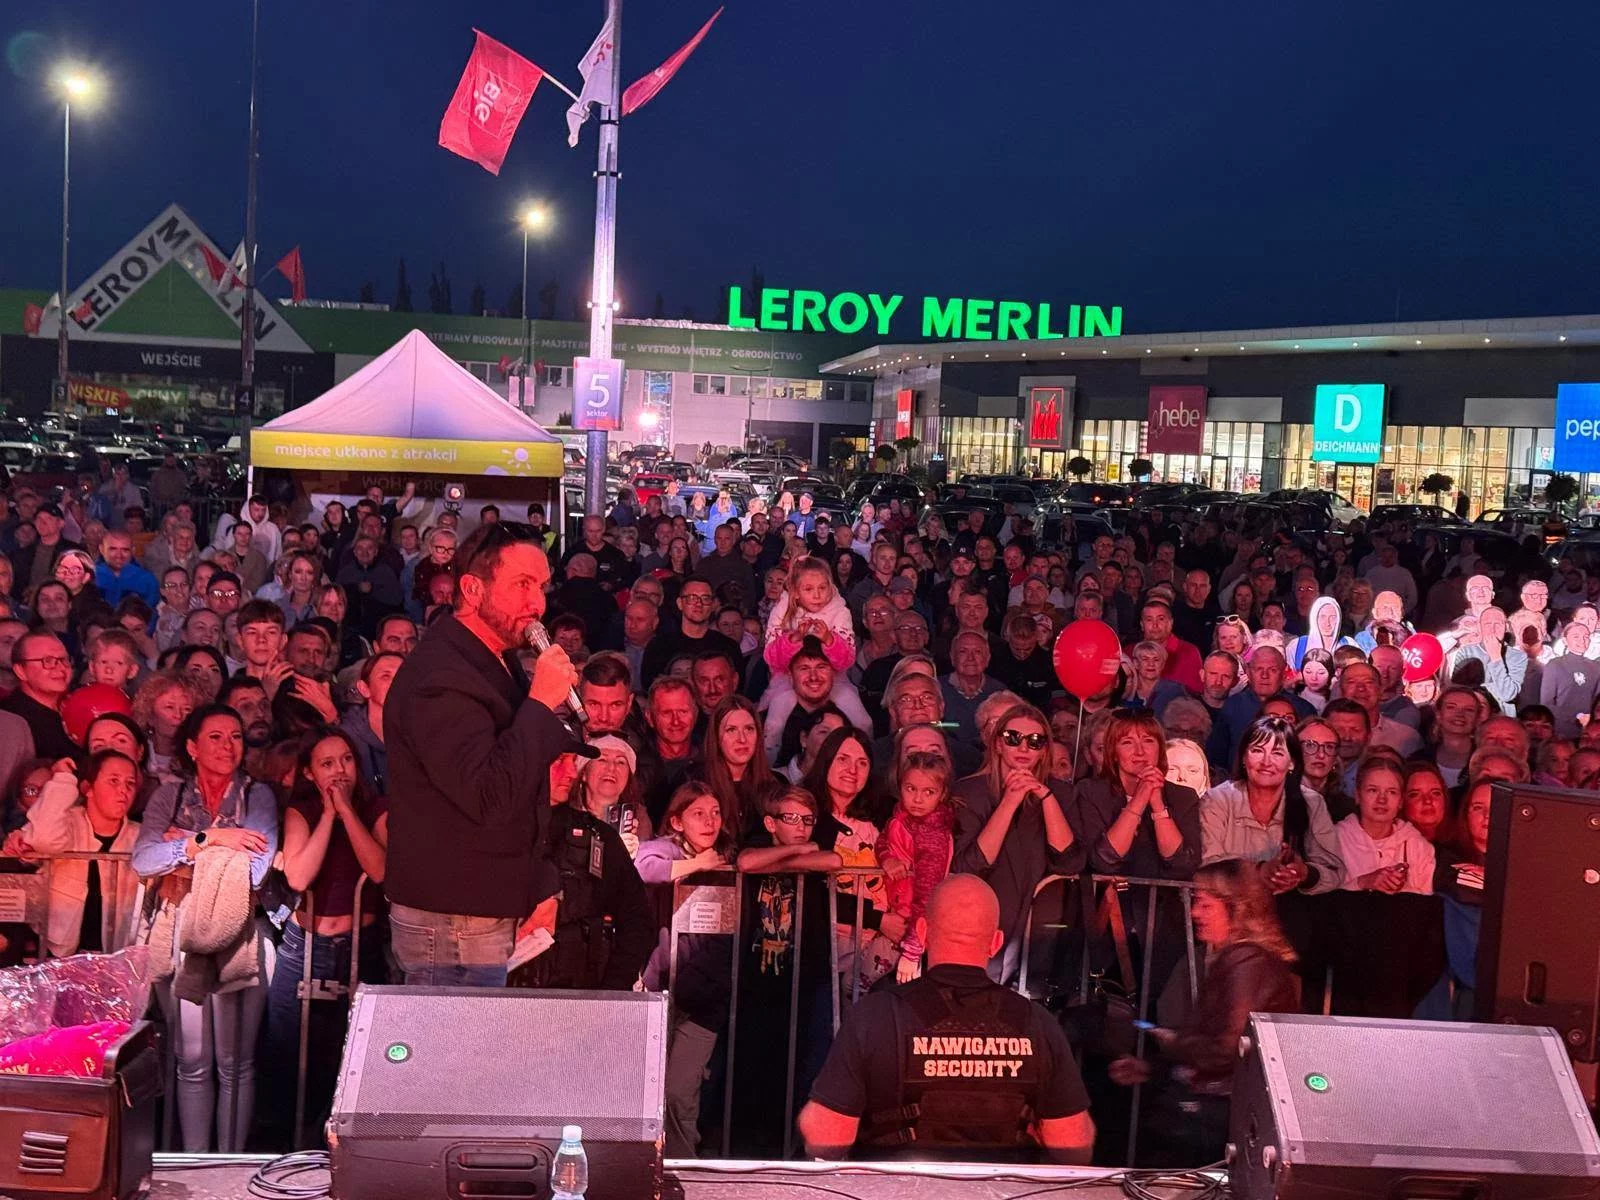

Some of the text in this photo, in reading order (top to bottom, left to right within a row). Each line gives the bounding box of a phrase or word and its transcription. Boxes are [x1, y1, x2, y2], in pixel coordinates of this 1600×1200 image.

[67, 234, 164, 332] LEROY
[728, 286, 1123, 341] LEROY MERLIN
[141, 351, 201, 367] WEJŚCIE
[731, 350, 803, 361] OGRODNICTWO
[70, 383, 120, 405] NISKIE
[588, 374, 610, 408] 5
[586, 409, 609, 417] sektor
[1159, 401, 1201, 428] hebe
[1335, 394, 1362, 433] D
[275, 443, 458, 462] miejsce utkane z atrakcji
[1315, 440, 1379, 454] DEICHMANN
[913, 1037, 1033, 1056] NAWIGATOR
[924, 1060, 1023, 1077] SECURITY
